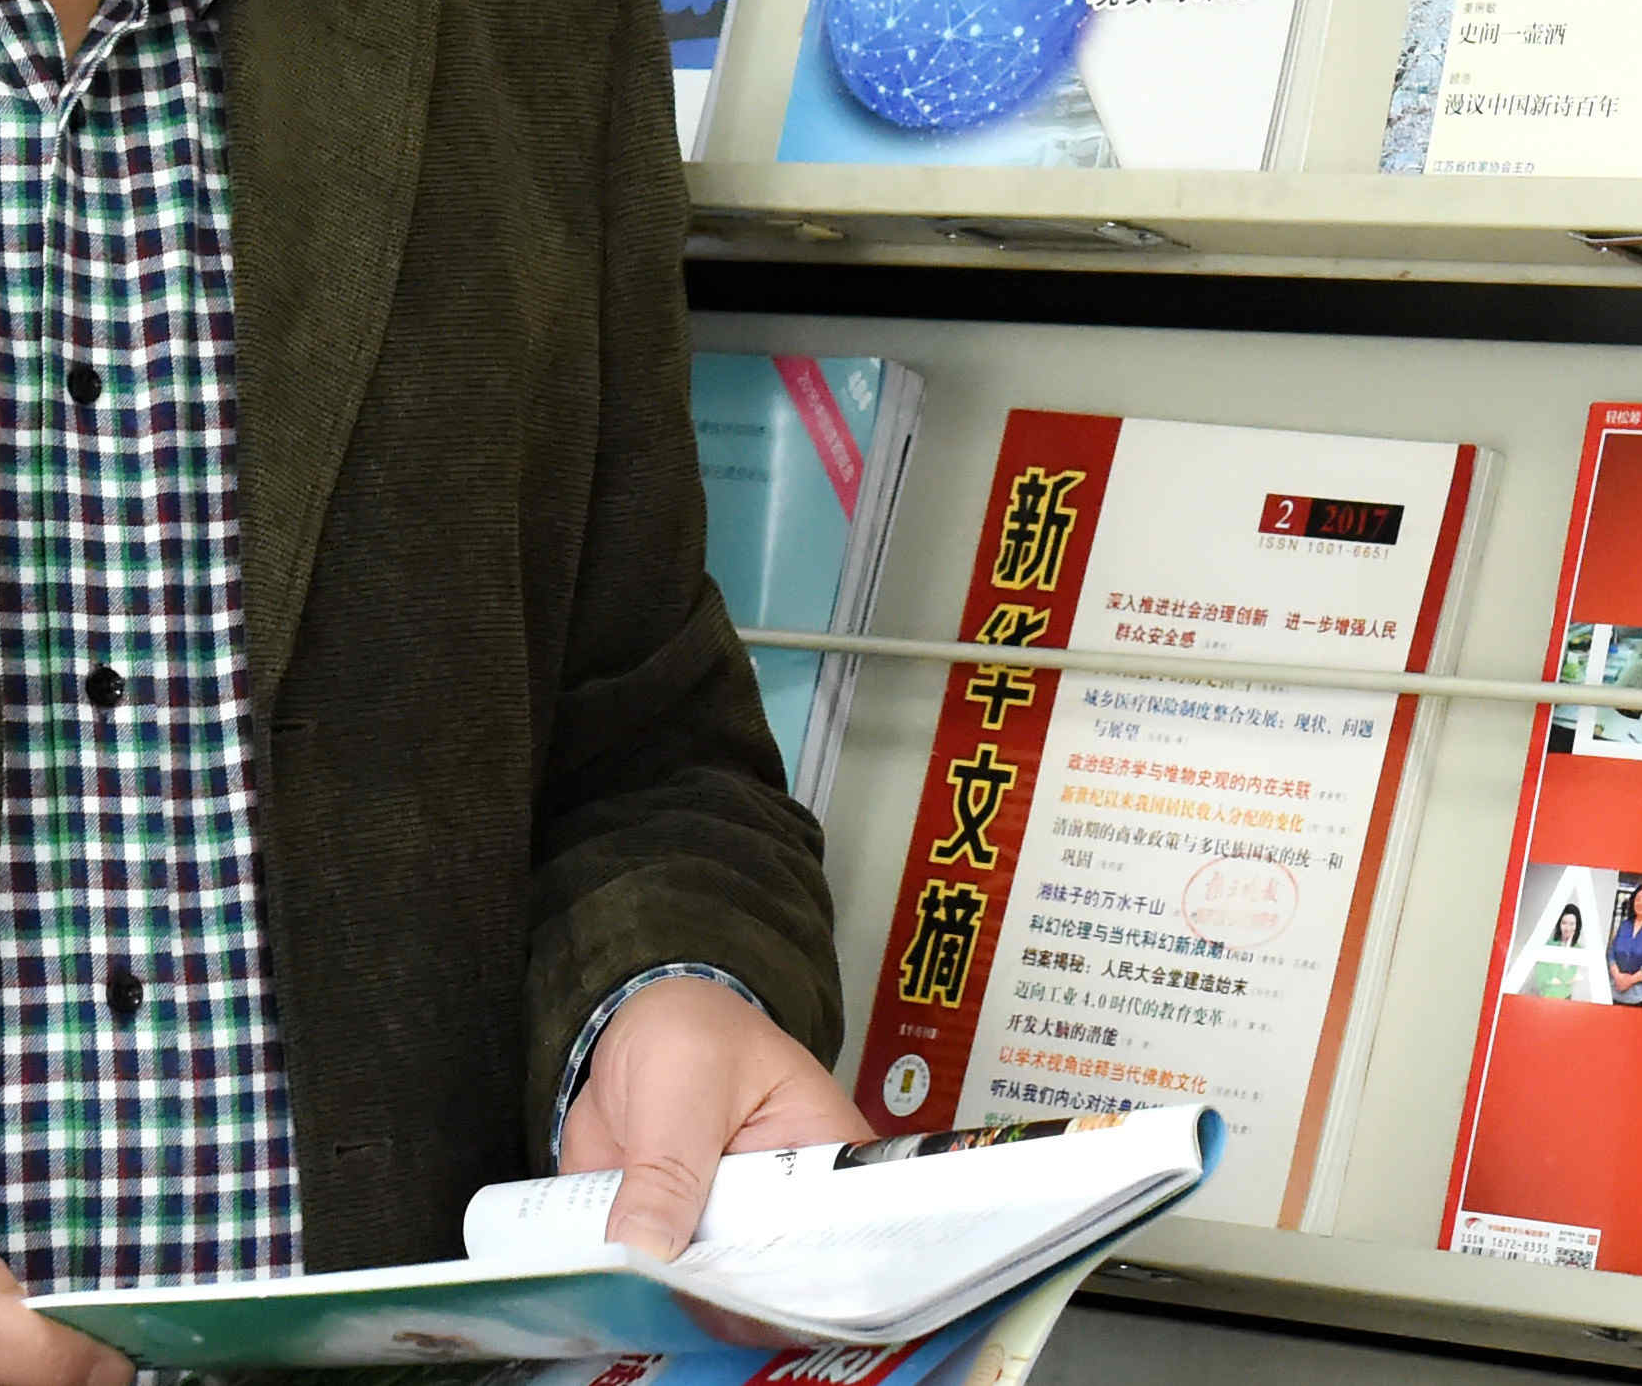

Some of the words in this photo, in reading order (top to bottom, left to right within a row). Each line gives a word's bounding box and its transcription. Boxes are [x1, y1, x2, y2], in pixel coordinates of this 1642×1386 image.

[1444, 93, 1620, 119] 漫议中国新诗百年
[1275, 498, 1294, 531] 2
[1320, 503, 1390, 538] 2017
[1259, 535, 1299, 552] ISSN
[1105, 590, 1268, 628] 深入推进社会治理创新
[1285, 609, 1399, 641] 进一步增强人民
[1114, 622, 1197, 649] 群众安全感
[898, 465, 1086, 1008] 新华文摘
[1093, 718, 1140, 742] 与展望
[1067, 752, 1312, 801] 政治经济学与唯物史观的内在关联
[1060, 846, 1093, 870] 巩固
[1036, 881, 1166, 917] 湘妹子的万水千山
[1029, 914, 1225, 961] 科幻伦理与当代科幻新浪潮
[1503, 864, 1614, 1006] A
[1006, 1014, 1119, 1048] 开发大脑的潜能
[998, 1044, 1208, 1096] 以学术视角诠释当代佛教文化
